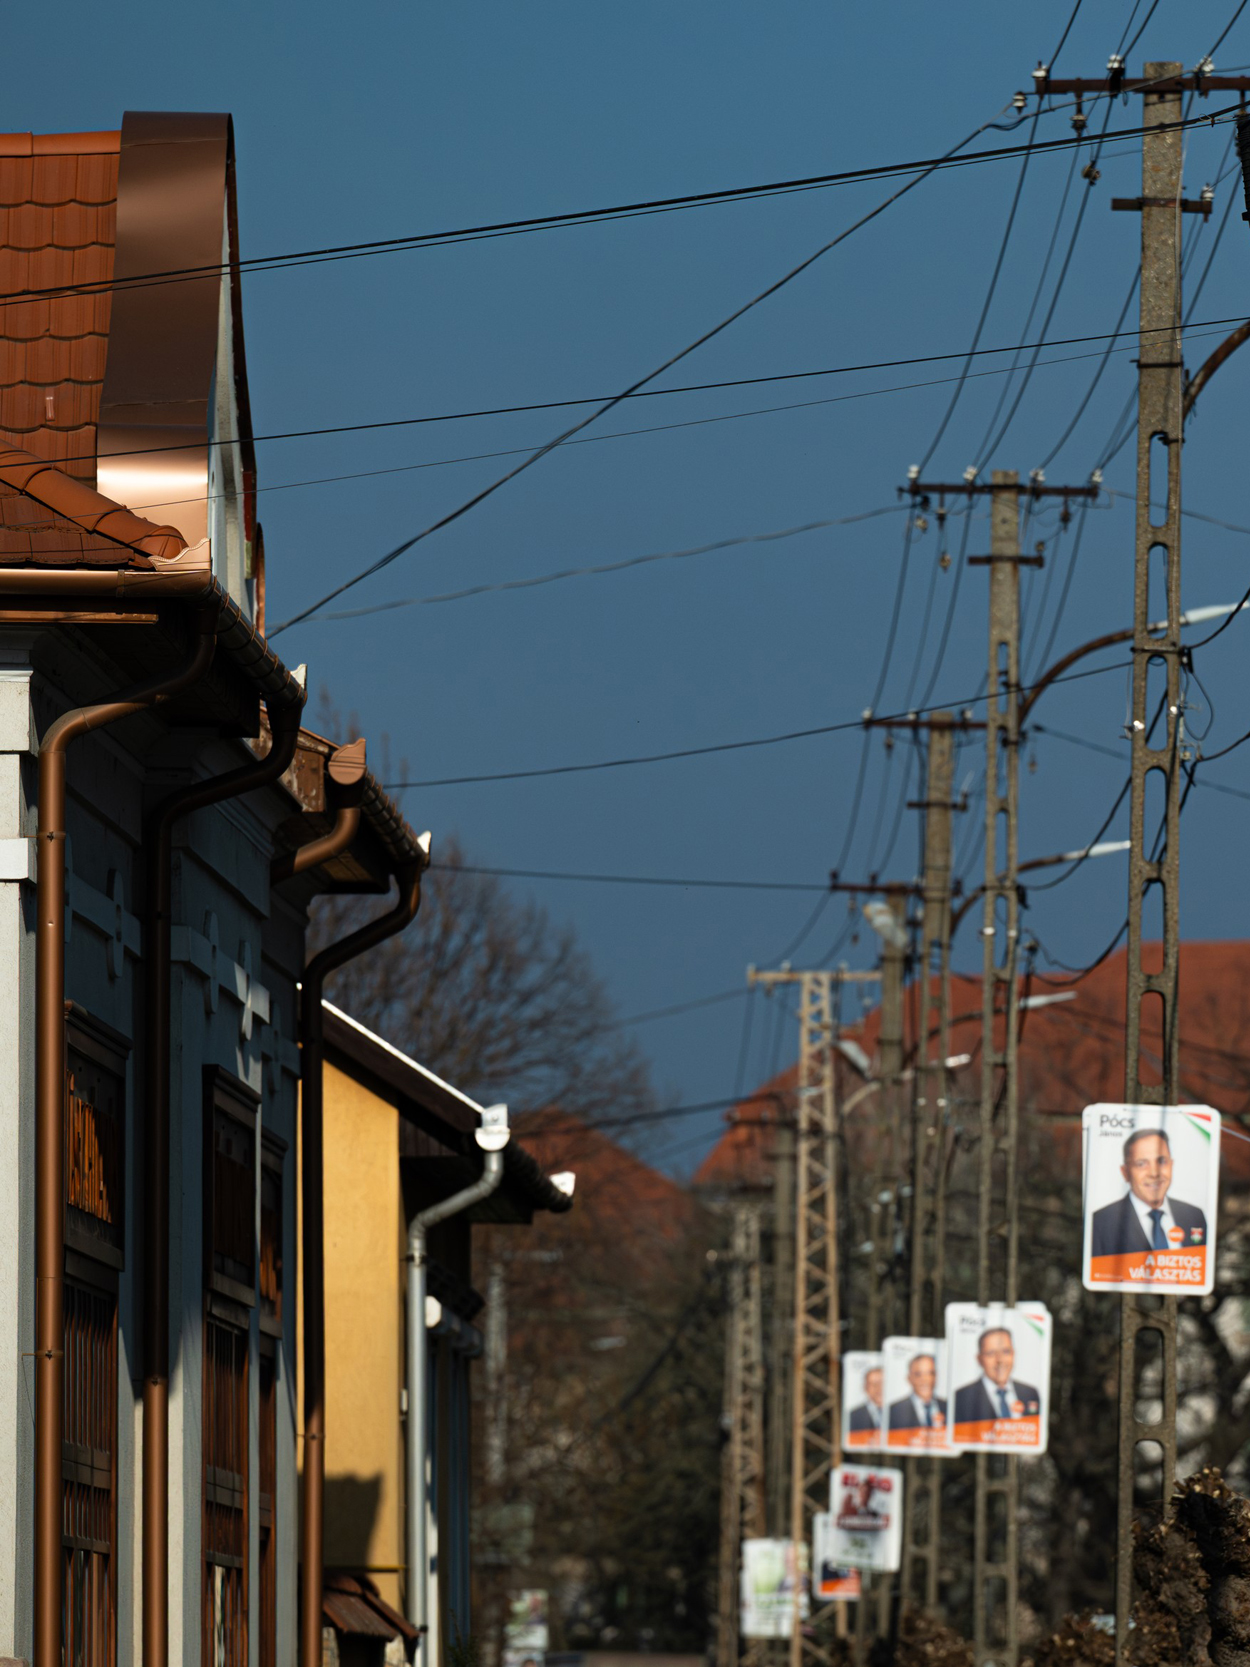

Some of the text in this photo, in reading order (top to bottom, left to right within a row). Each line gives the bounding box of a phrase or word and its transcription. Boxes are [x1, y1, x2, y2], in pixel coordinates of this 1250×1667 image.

[1099, 1114, 1135, 1129] Pócs
[1145, 1254, 1202, 1269] A BIZTOS
[1129, 1265, 1201, 1282] VÁLASZTÁS
